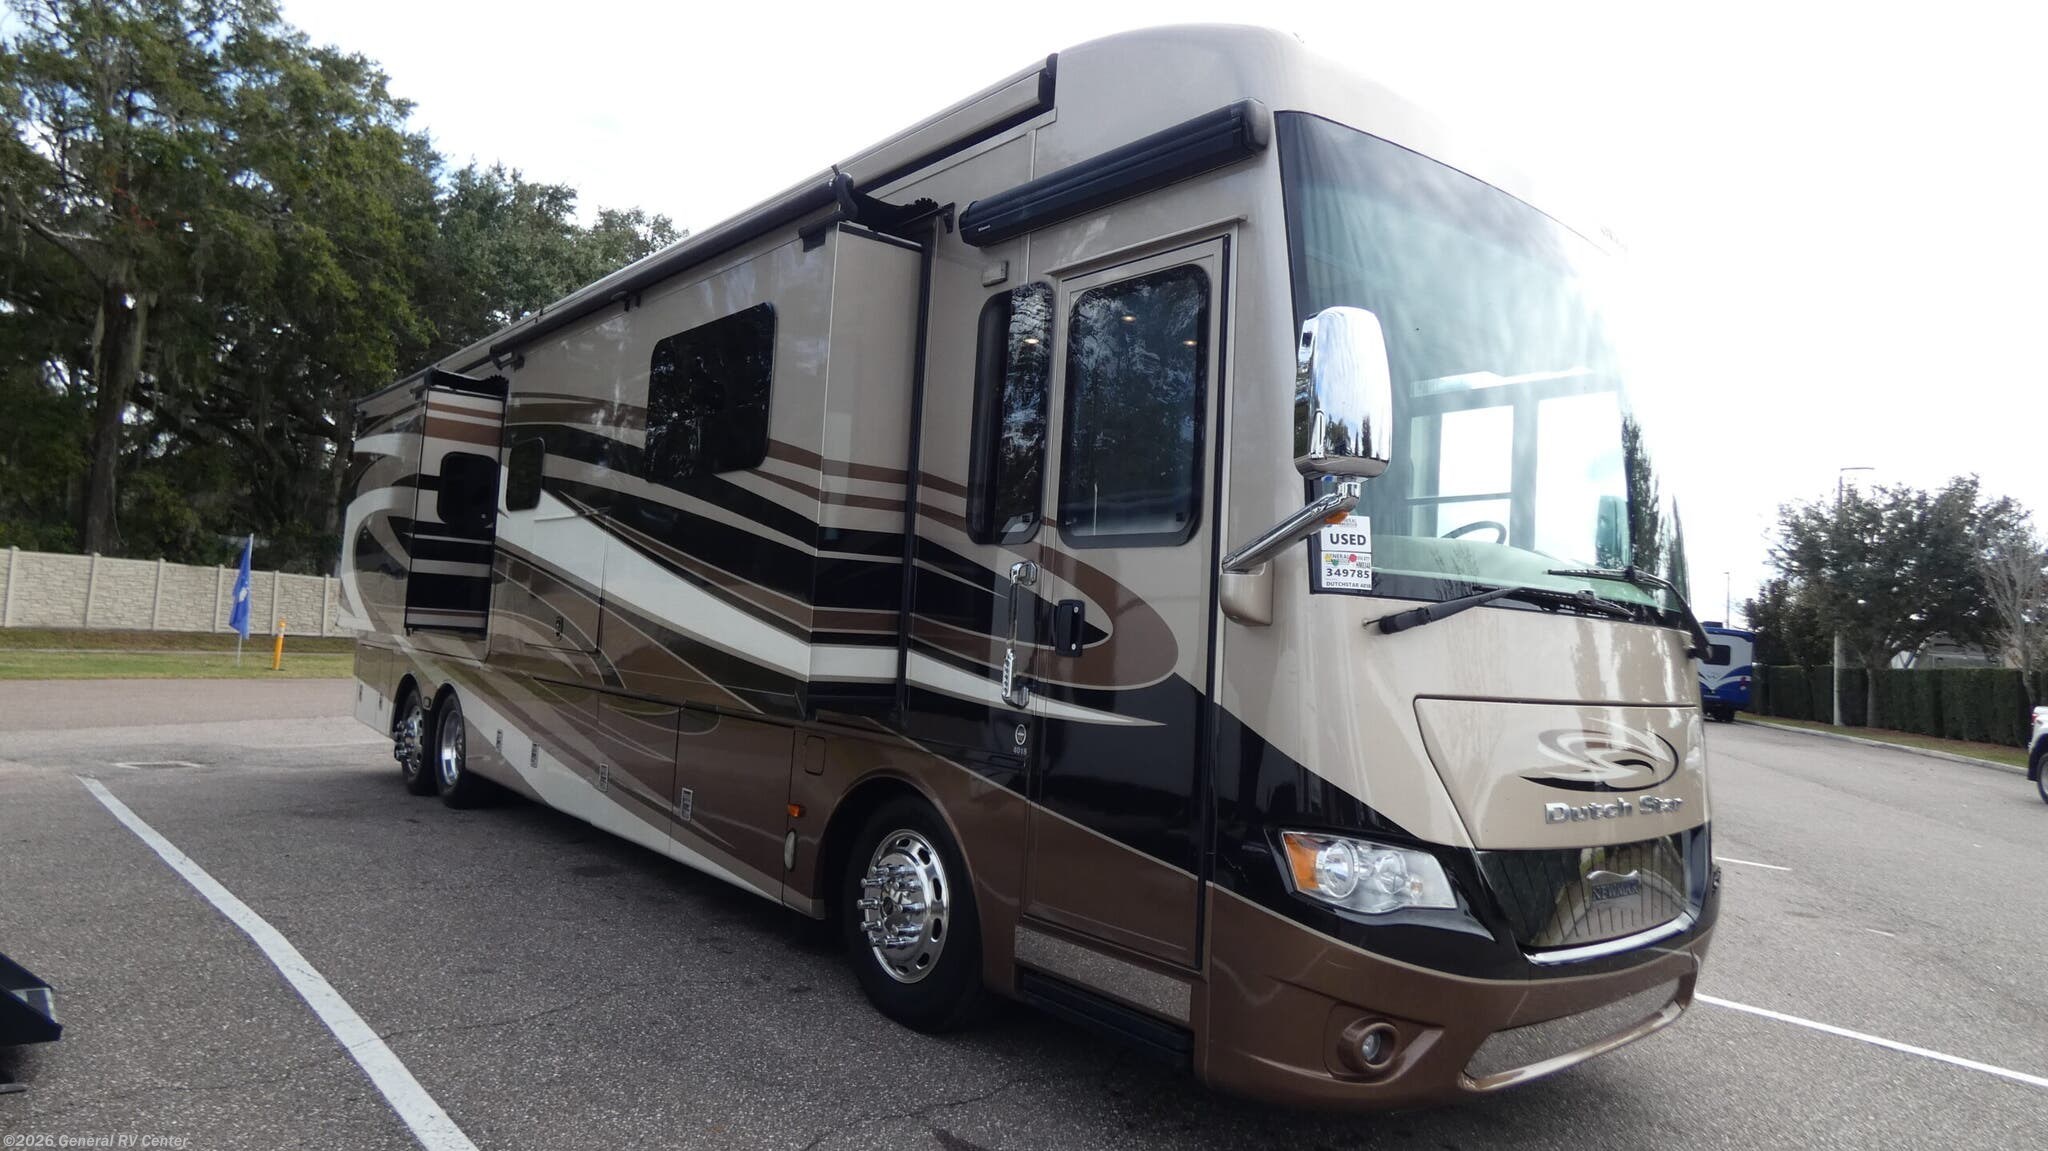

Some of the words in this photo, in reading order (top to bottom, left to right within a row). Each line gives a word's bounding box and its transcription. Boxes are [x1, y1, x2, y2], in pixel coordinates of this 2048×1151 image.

[1330, 533, 1366, 545] USED
[1326, 568, 1370, 579] 349785
[1545, 797, 1632, 824] Dutch
[1639, 795, 1683, 814] Star
